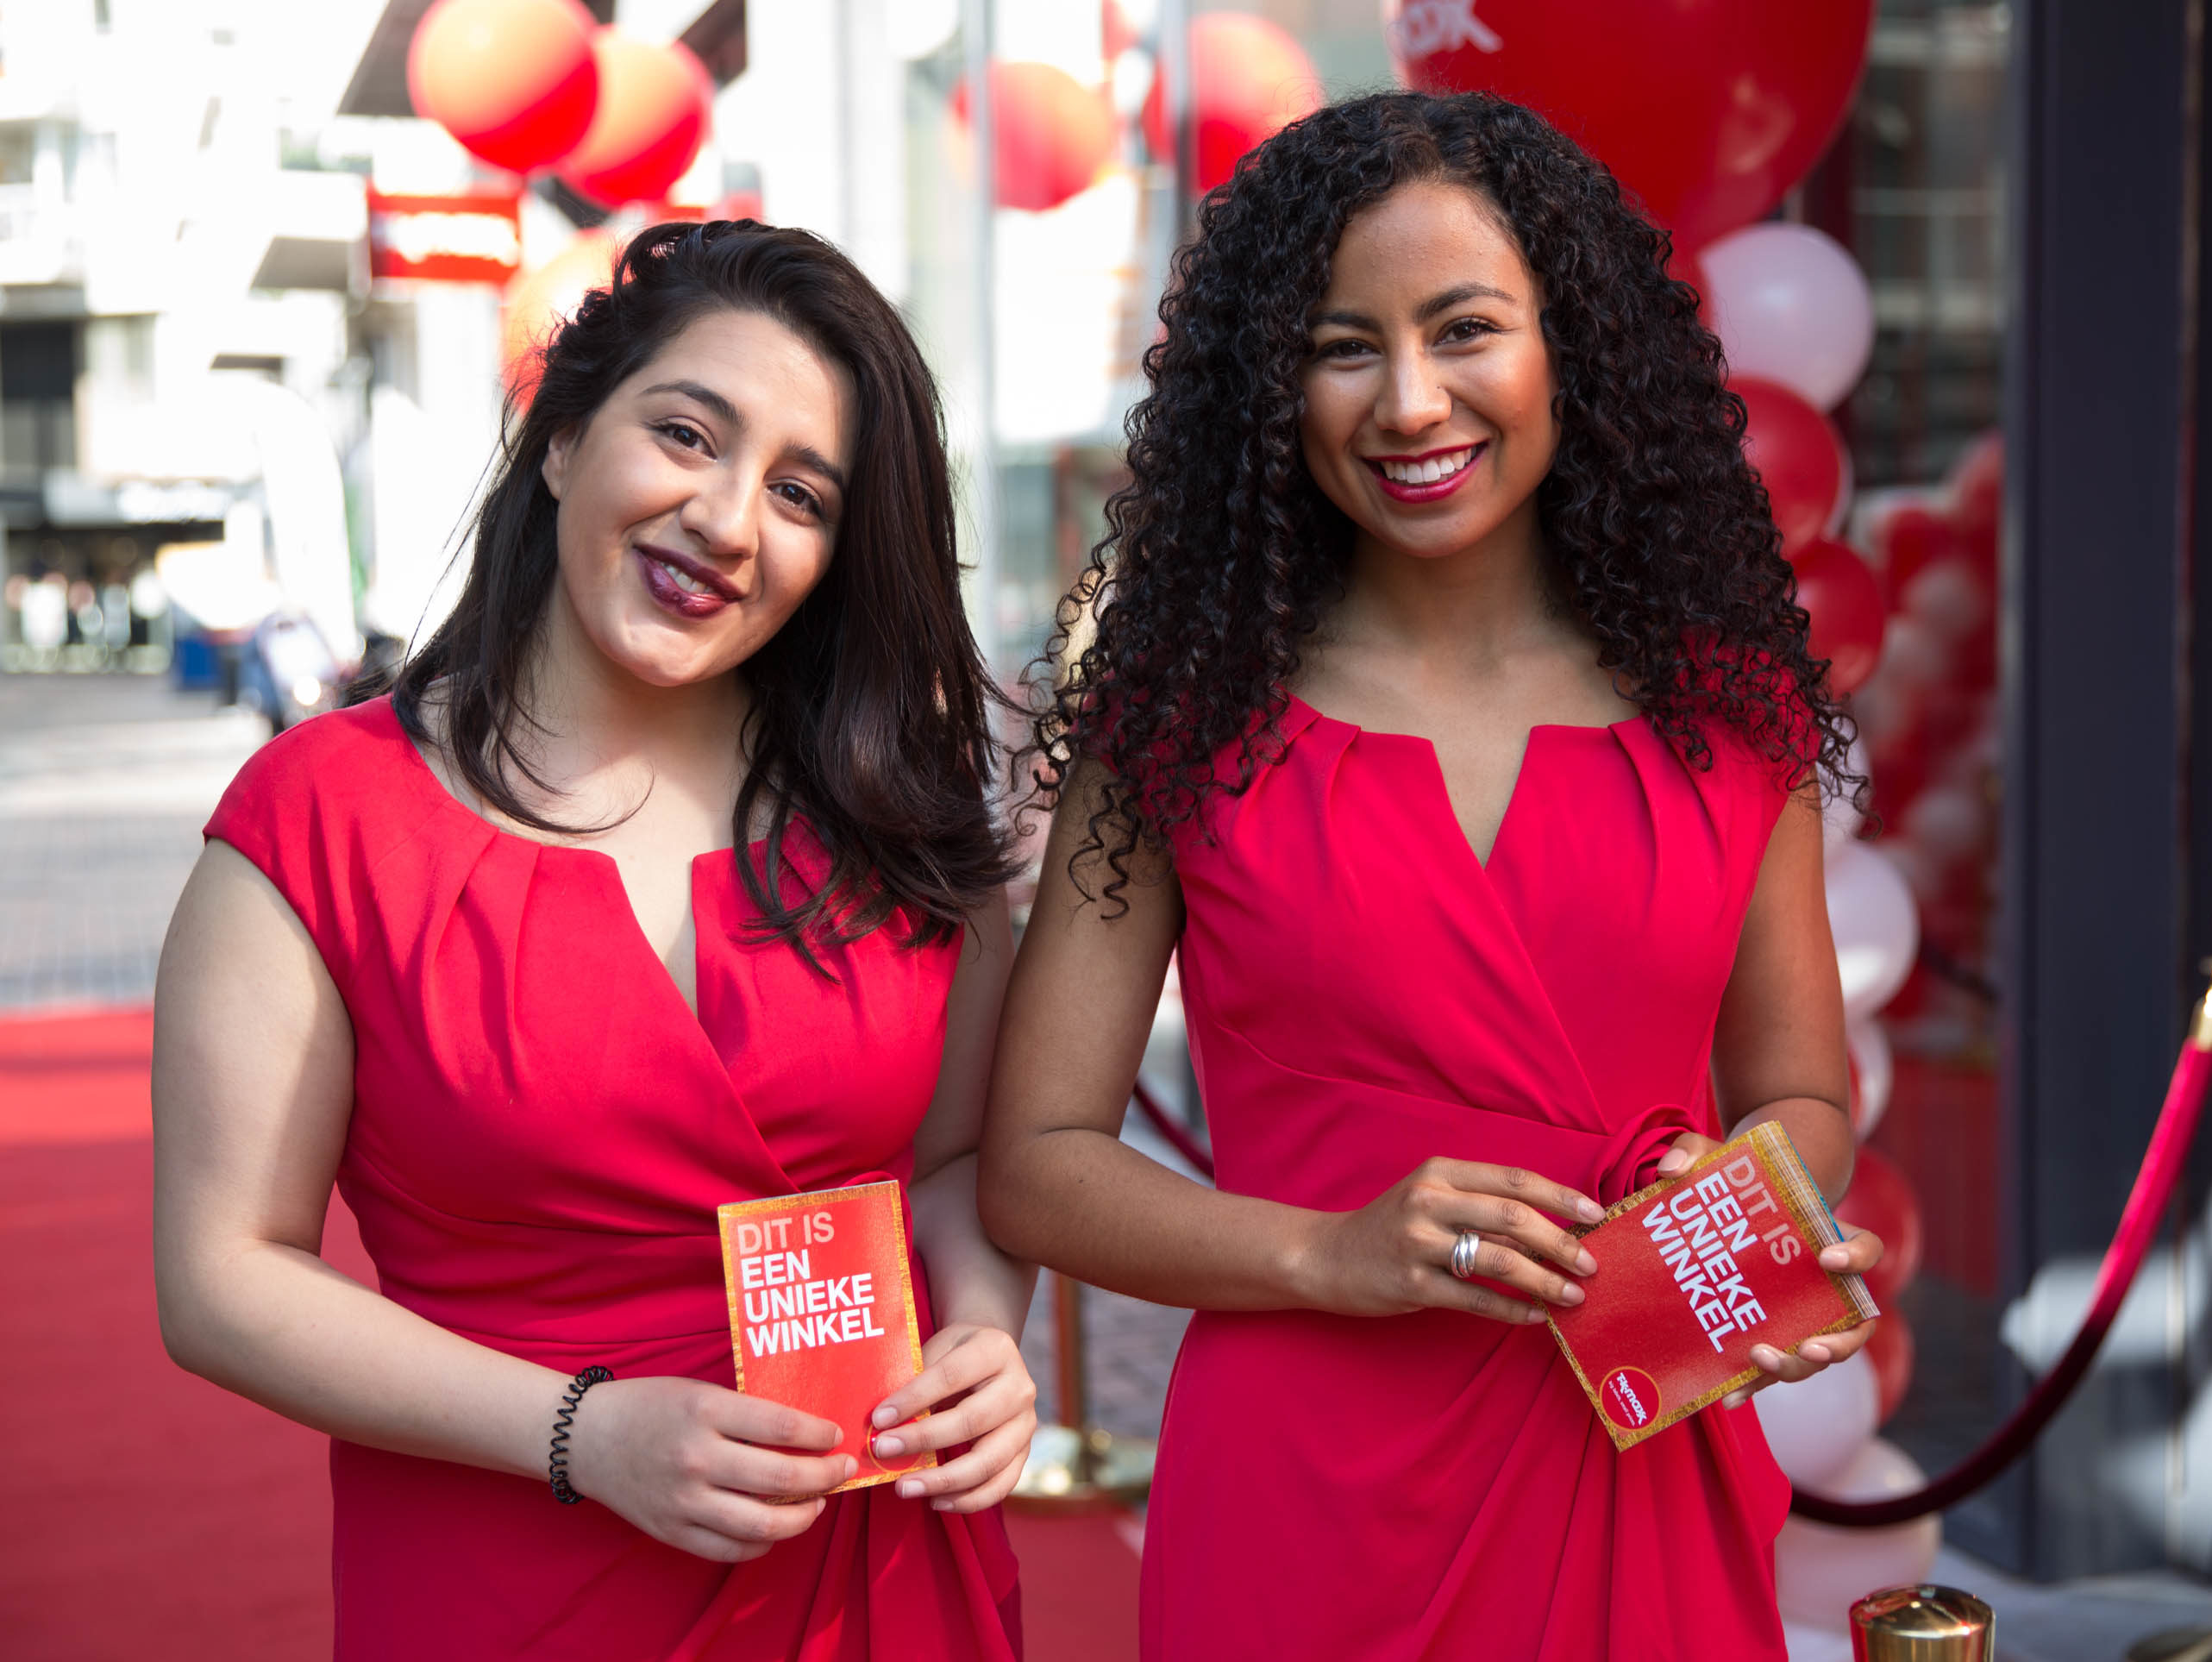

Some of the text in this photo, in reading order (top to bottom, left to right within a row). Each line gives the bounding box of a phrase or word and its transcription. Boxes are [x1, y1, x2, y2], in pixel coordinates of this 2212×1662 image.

[737, 1211, 835, 1255] DIT IS
[1695, 1171, 1758, 1253] EEN
[1722, 1157, 1802, 1264] DIT IS
[741, 1249, 811, 1289] EEN
[1642, 1201, 1735, 1353] WINKEL
[1670, 1187, 1767, 1332] UNIEKE
[744, 1273, 875, 1323] UNIEKE
[747, 1308, 885, 1358] WINKEL
